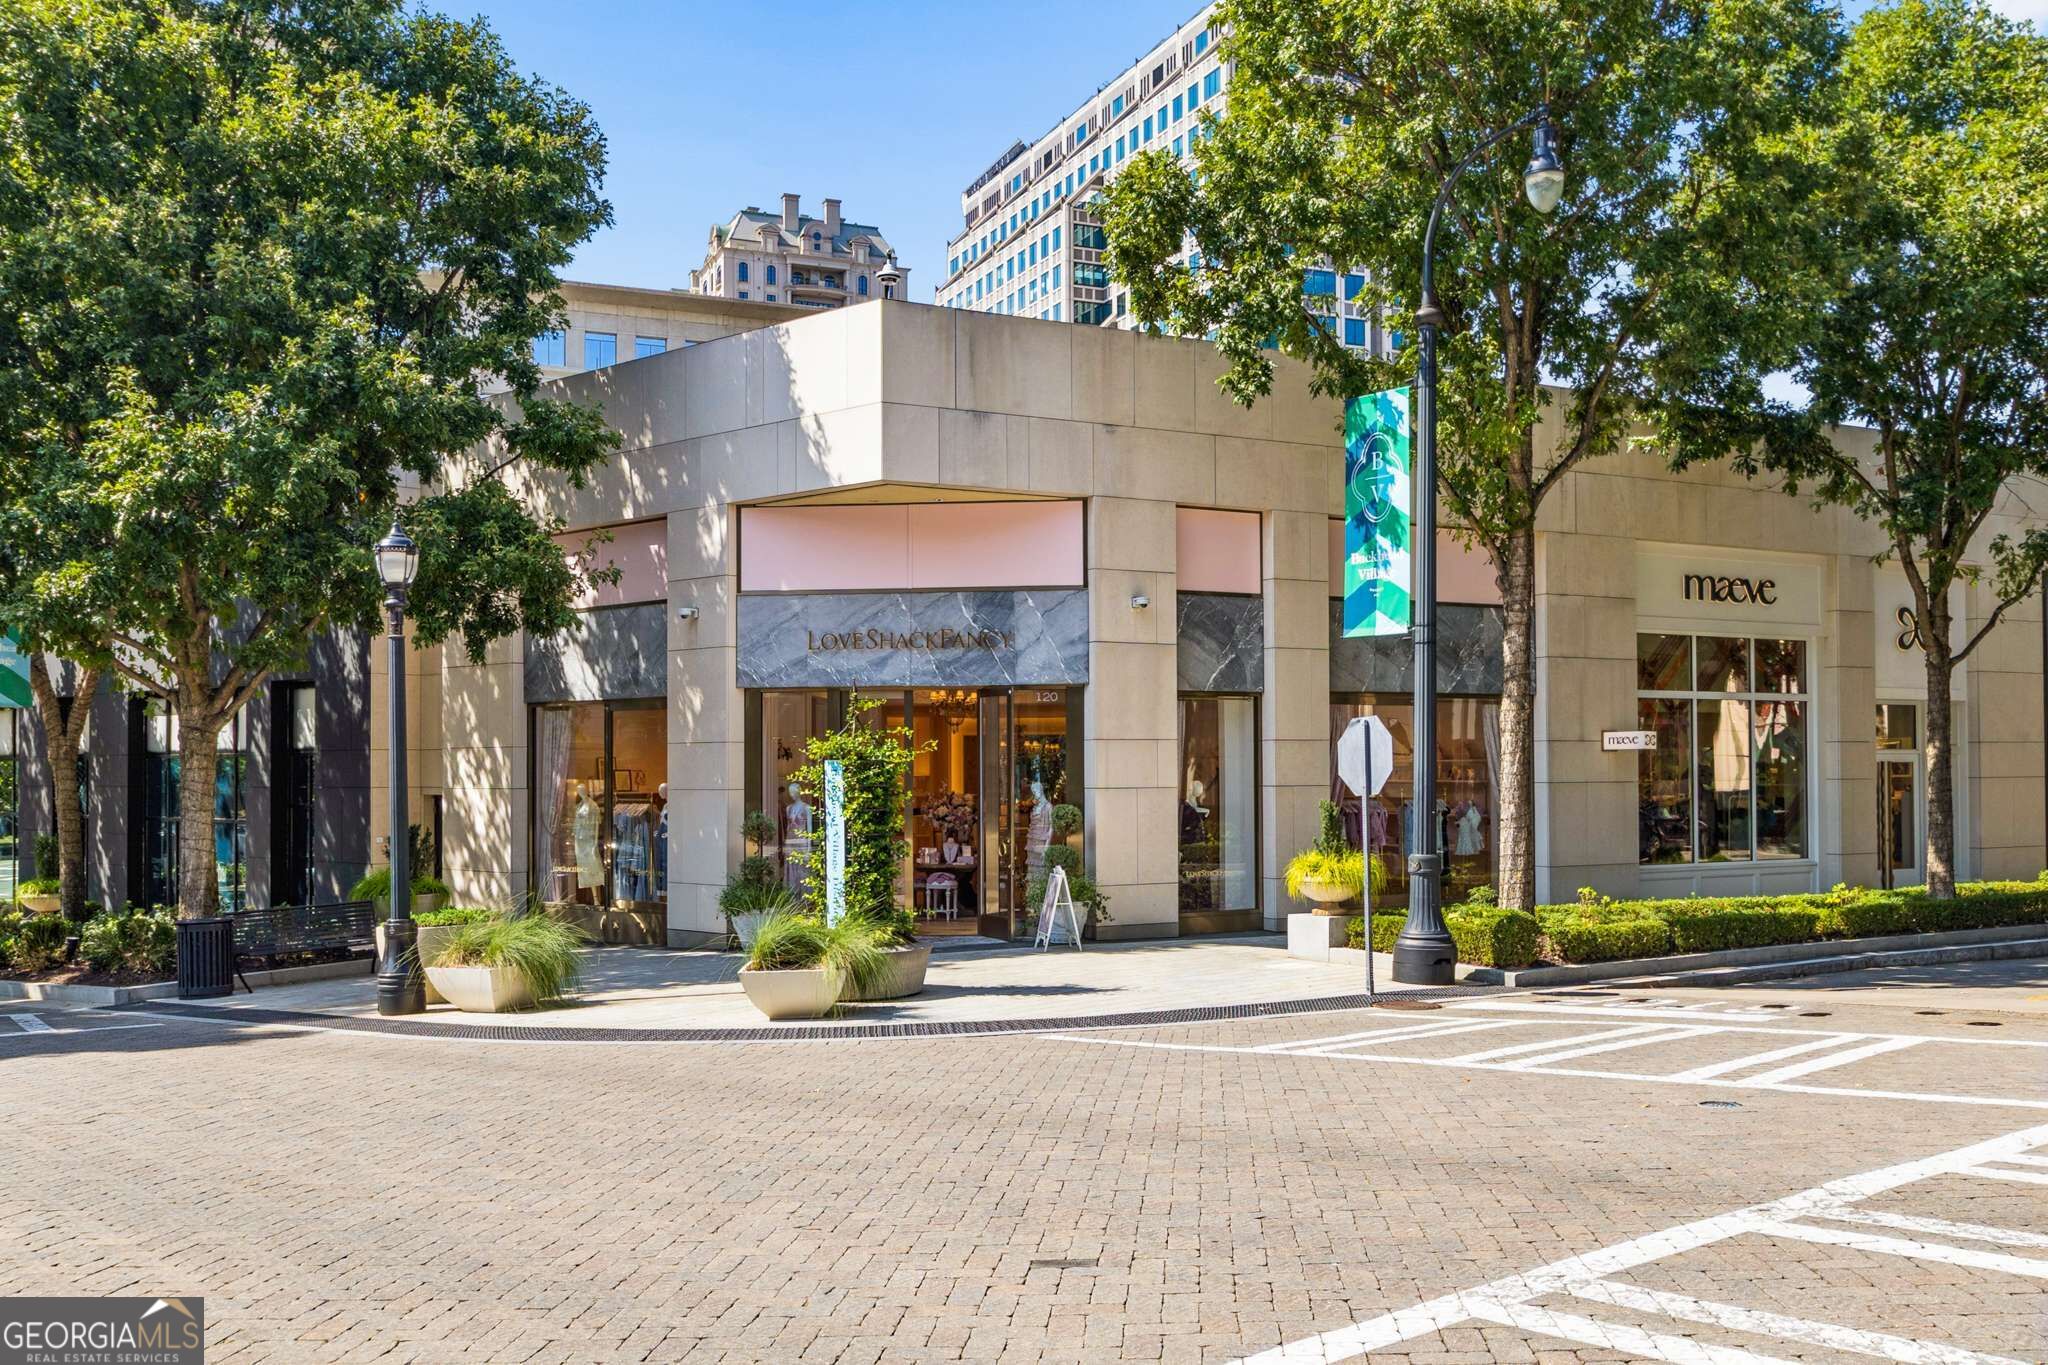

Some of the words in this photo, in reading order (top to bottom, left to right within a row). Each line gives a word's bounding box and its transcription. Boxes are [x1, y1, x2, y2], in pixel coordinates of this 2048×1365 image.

[1371, 451, 1384, 471] B
[1371, 484, 1385, 503] V
[1682, 574, 1778, 606] maeve
[1035, 691, 1059, 702] 120
[1608, 735, 1640, 744] maeve
